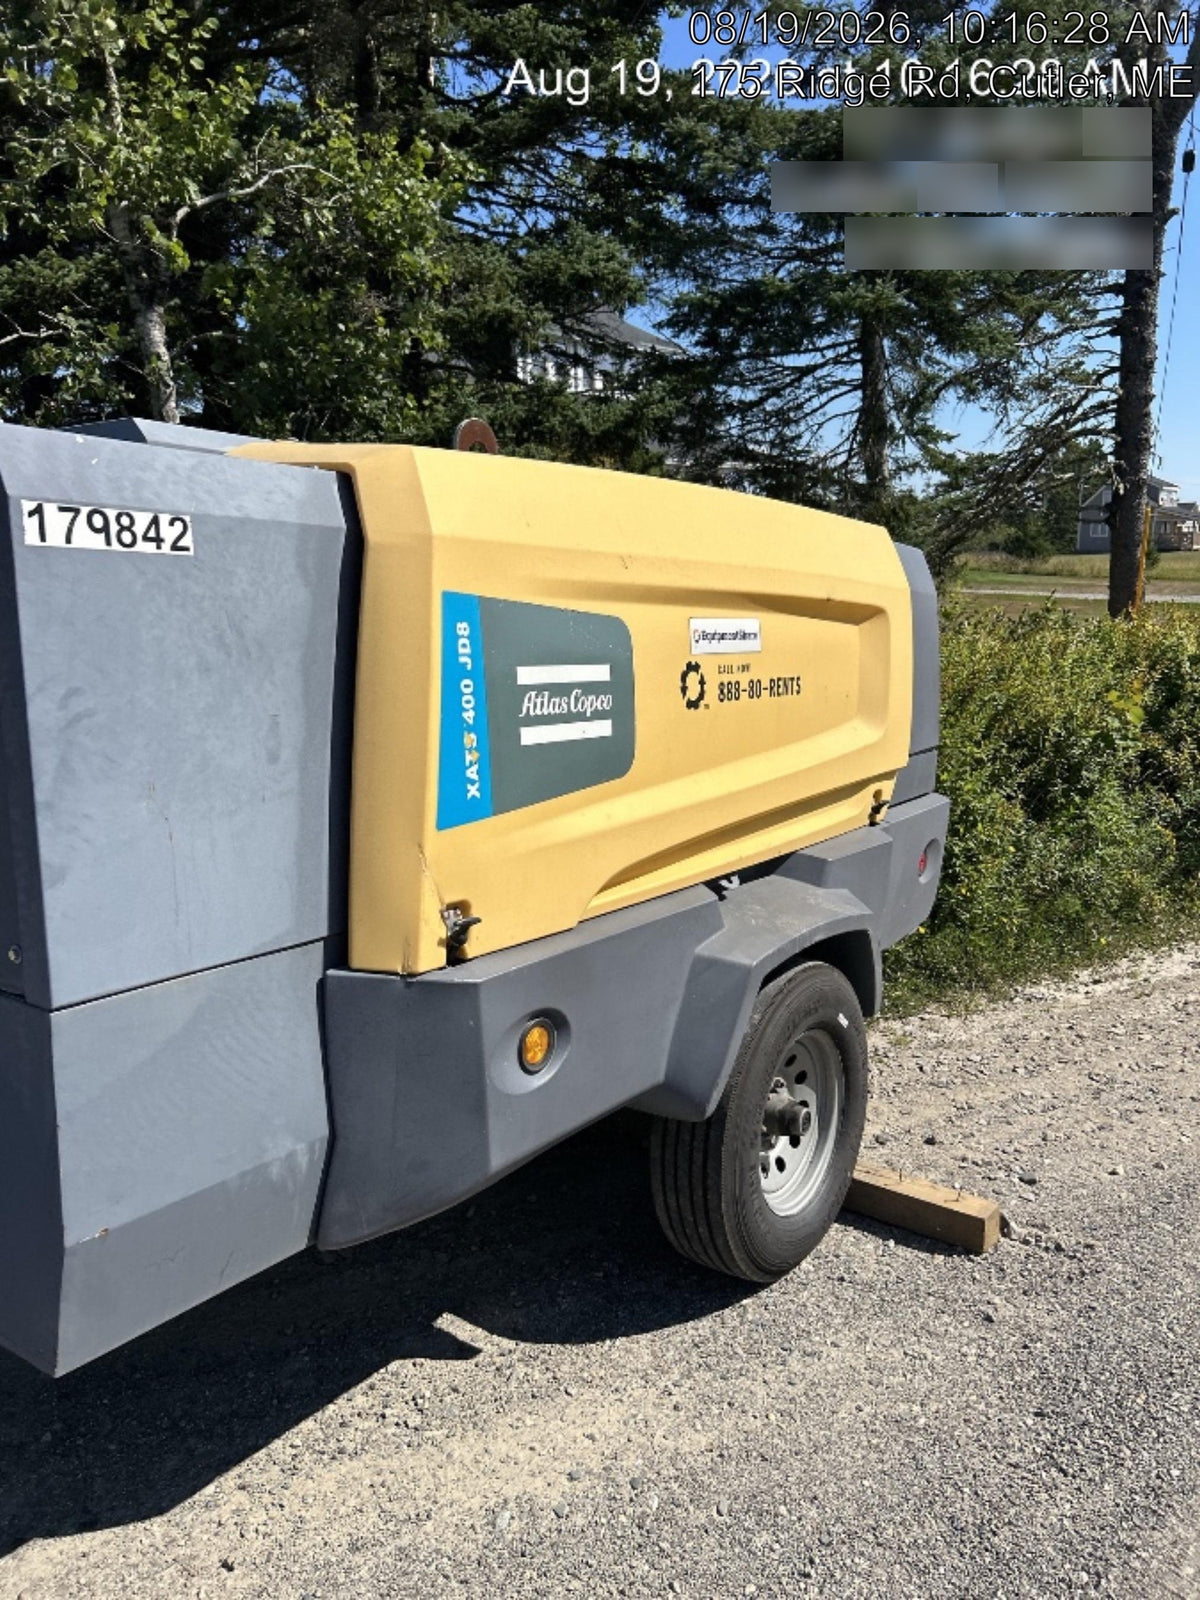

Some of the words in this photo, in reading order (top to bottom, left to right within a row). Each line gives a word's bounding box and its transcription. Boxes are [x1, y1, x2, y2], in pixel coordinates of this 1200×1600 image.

[28, 503, 190, 552] 179842
[456, 621, 472, 671] JD8
[461, 678, 476, 725] 400
[518, 690, 568, 718] Atlas
[570, 688, 613, 717] Copco
[718, 677, 801, 703] 888-80-RENTS
[464, 730, 481, 800] XATS
